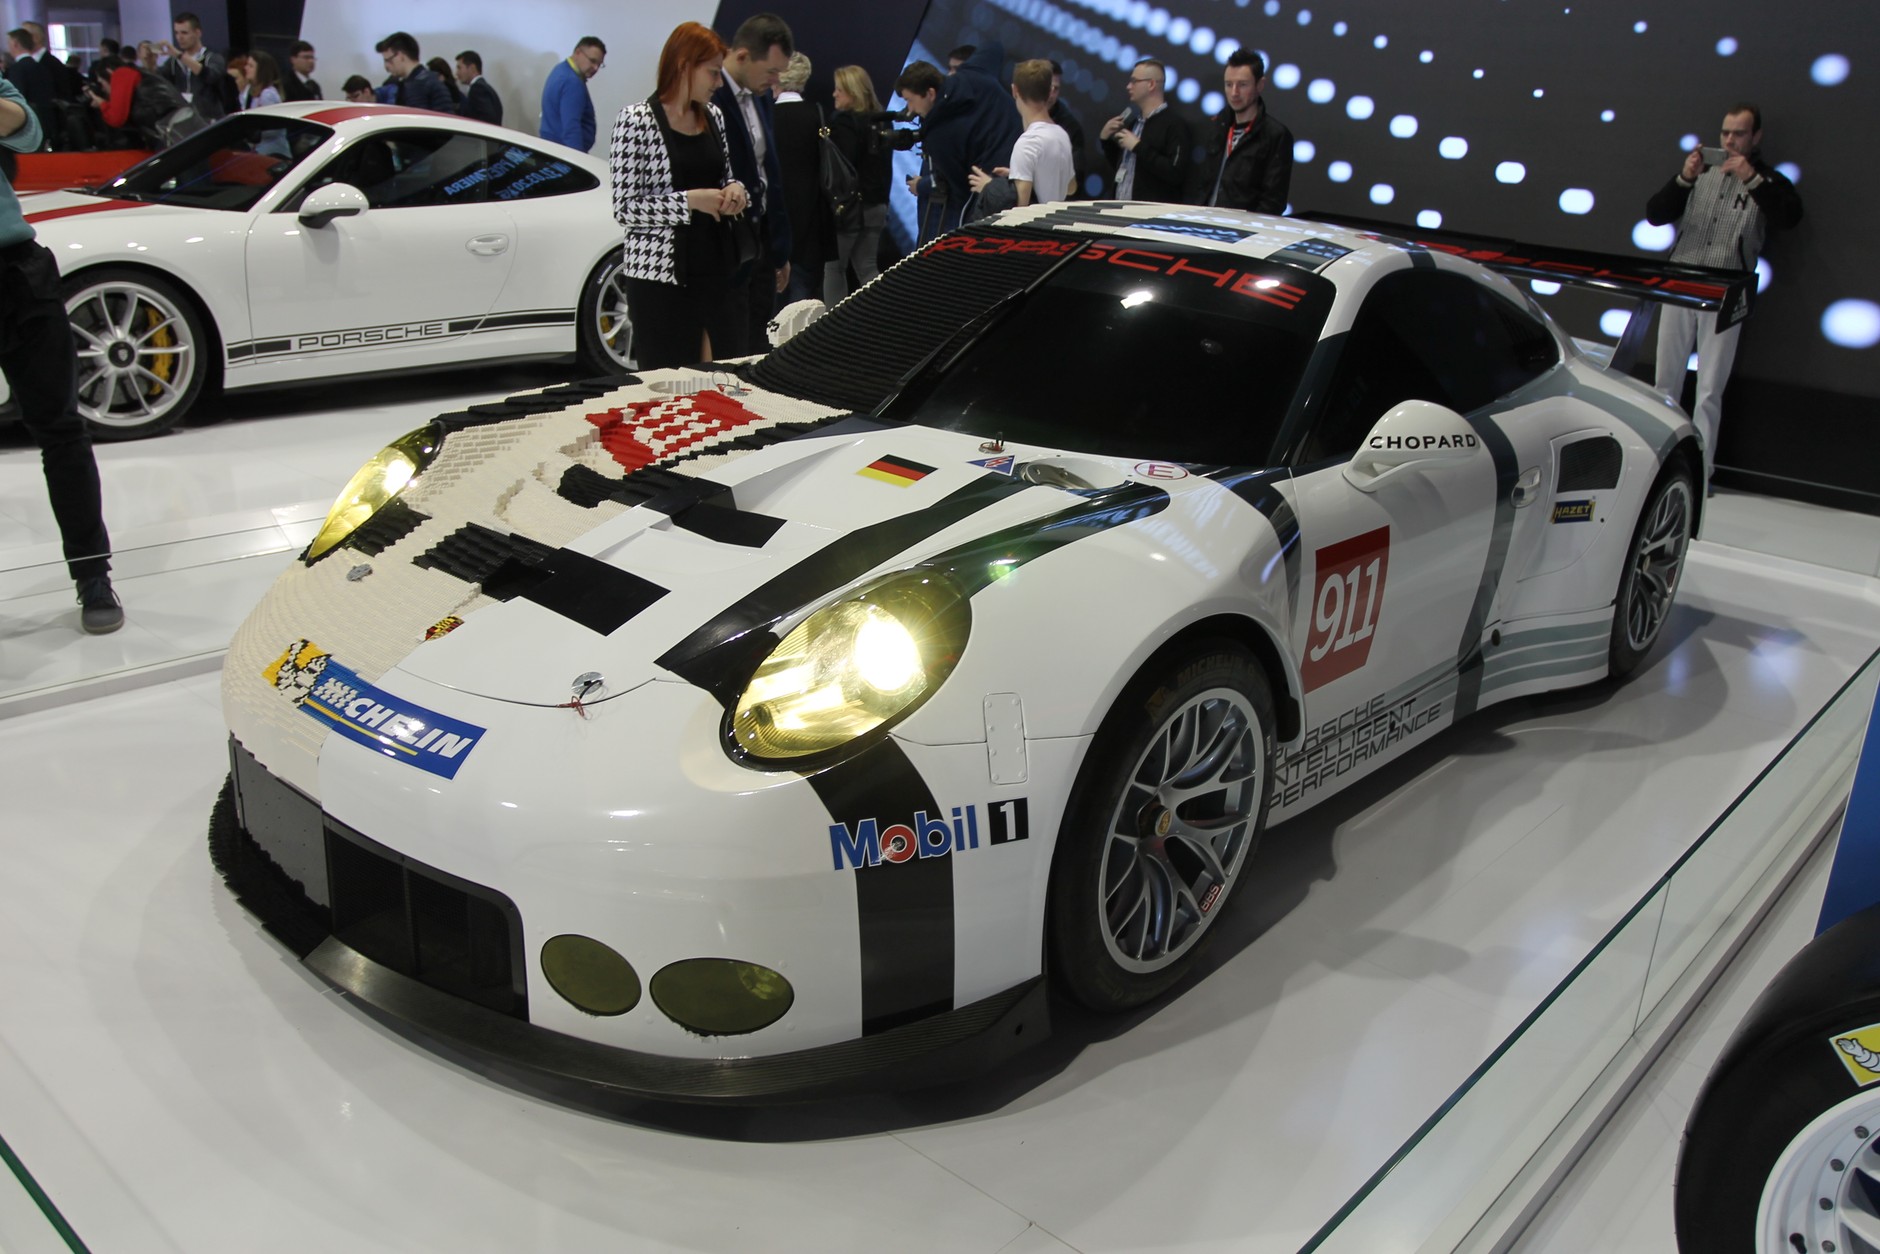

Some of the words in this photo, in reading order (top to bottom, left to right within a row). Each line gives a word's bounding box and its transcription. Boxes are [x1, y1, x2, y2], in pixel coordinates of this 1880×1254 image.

[922, 235, 1307, 310] PORSCHE
[299, 323, 443, 350] PORSCHE
[1370, 434, 1476, 449] CHOPARD
[1554, 505, 1591, 518] HAZET
[1310, 557, 1380, 662] 911
[312, 677, 473, 759] MICHELIN
[1270, 703, 1441, 808] PERFORMANCE
[829, 805, 978, 870] Mobil
[1201, 884, 1220, 911] BBS
